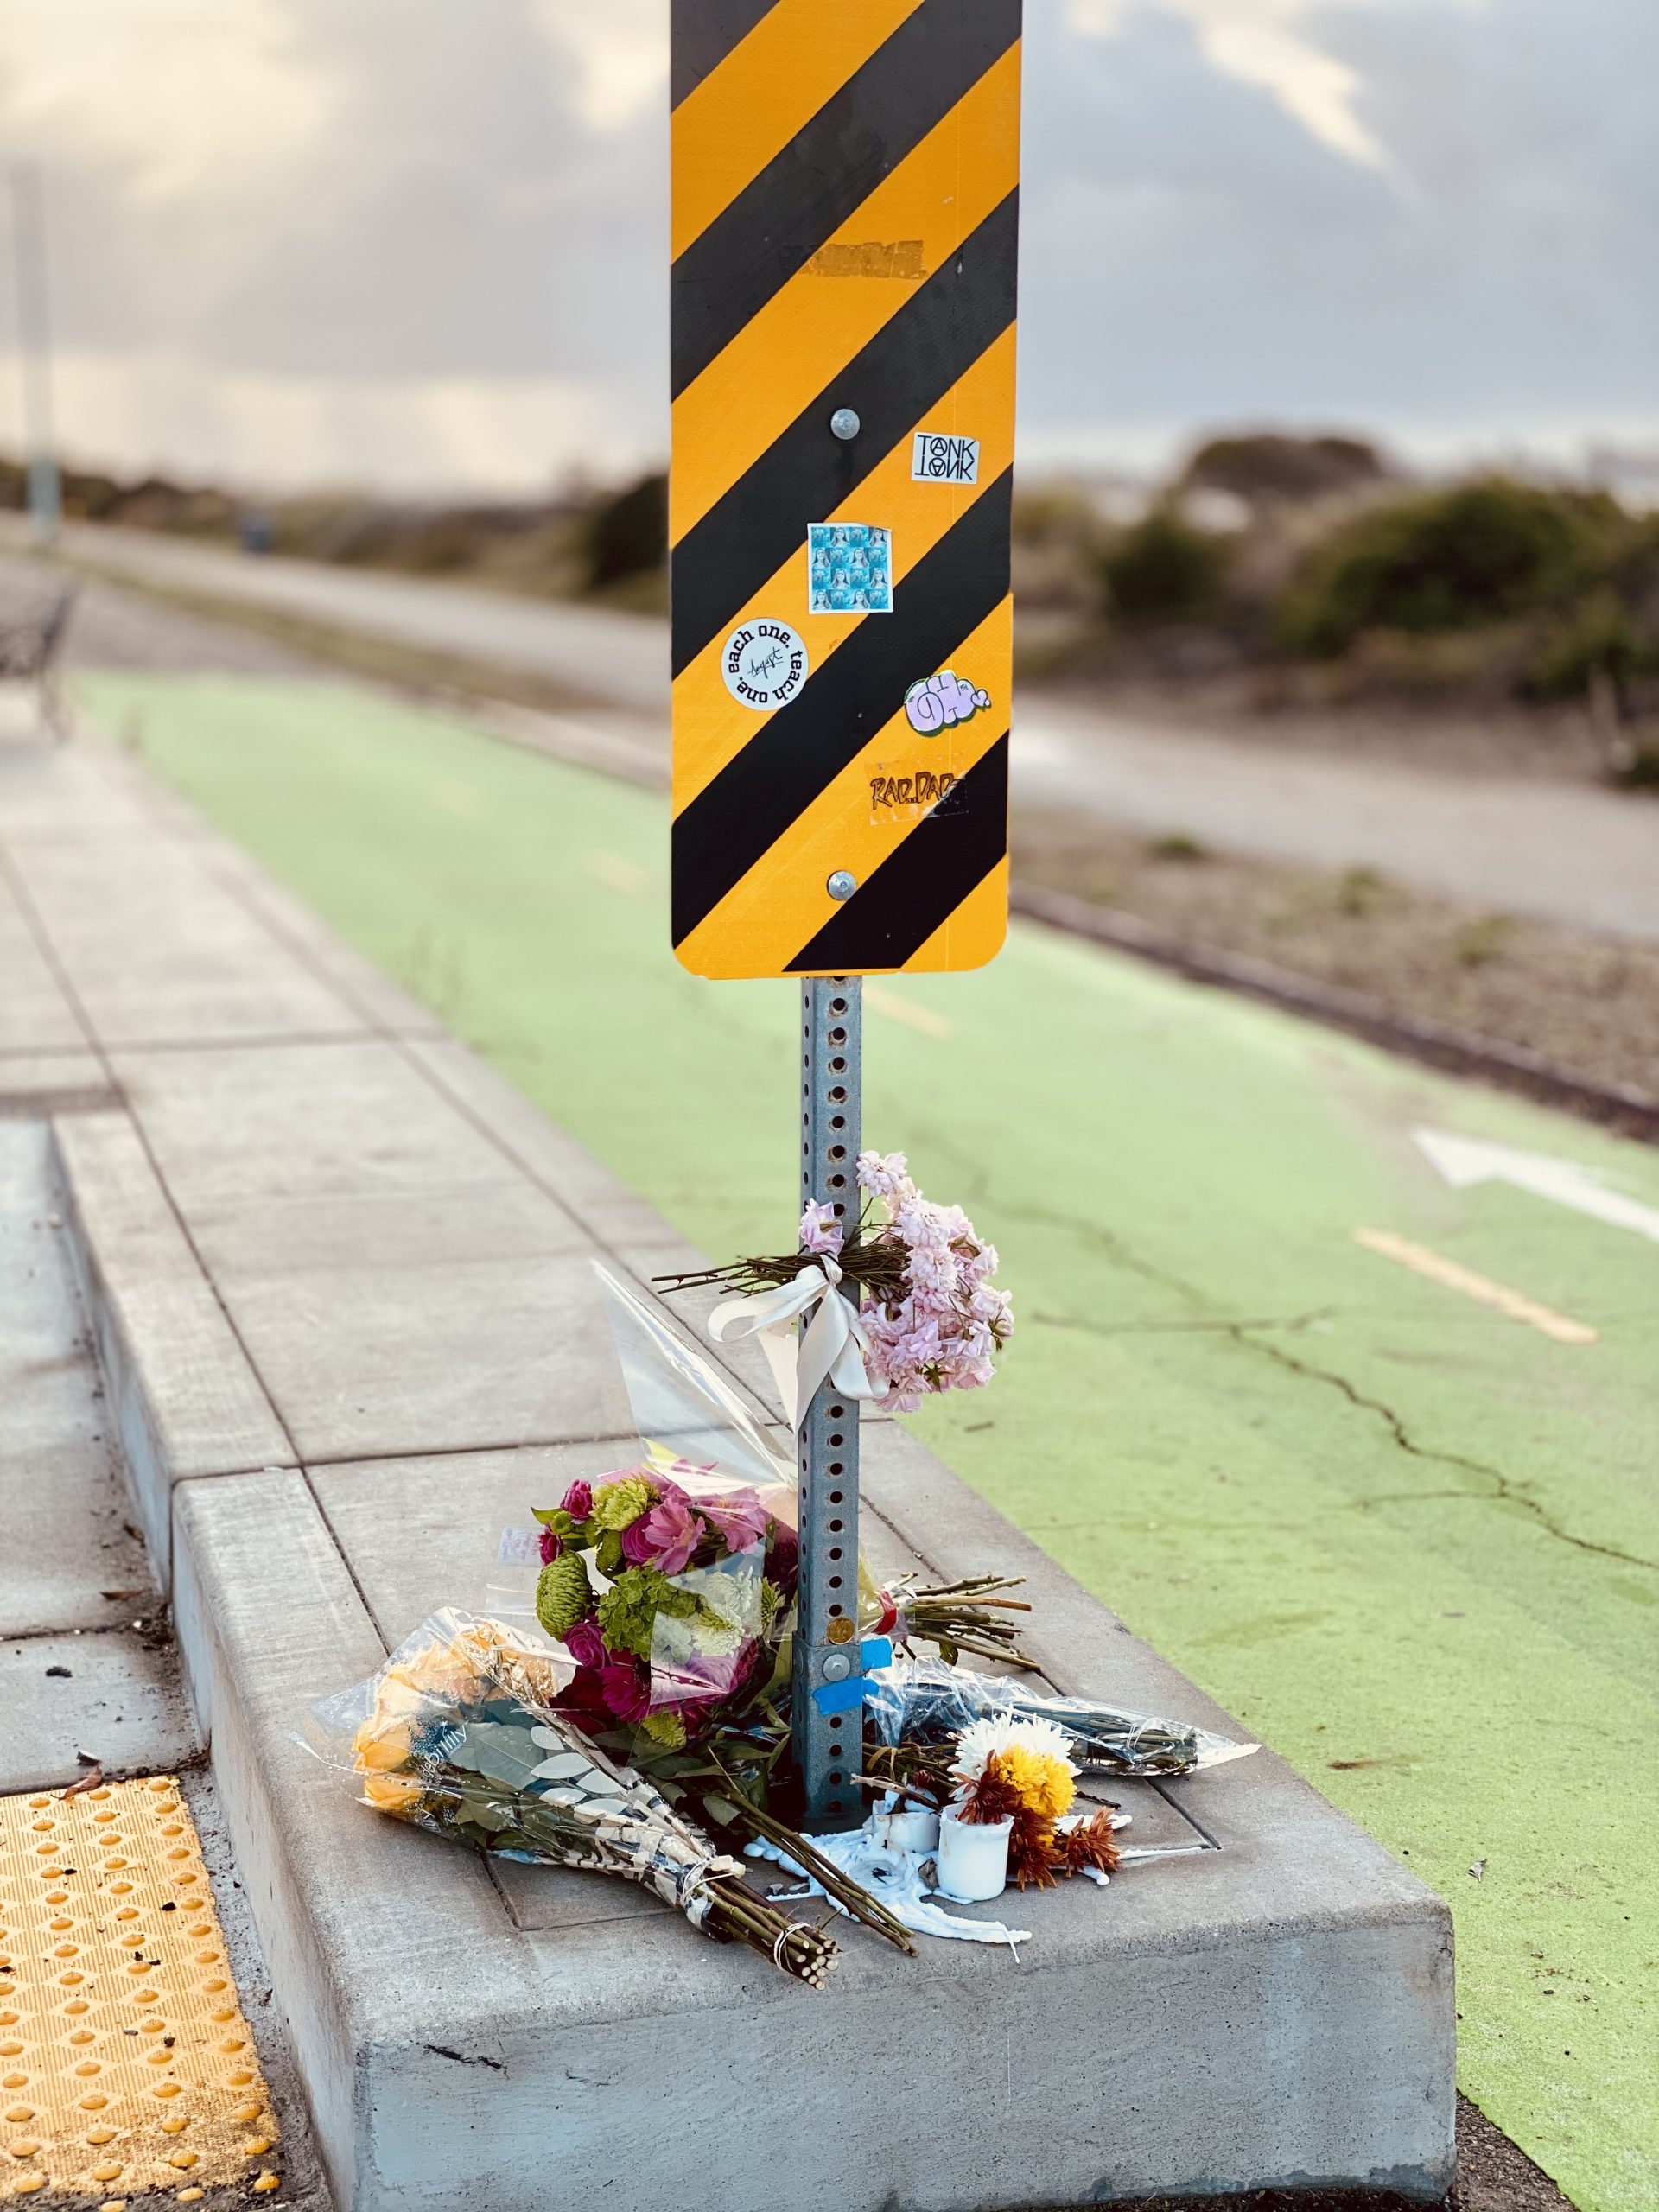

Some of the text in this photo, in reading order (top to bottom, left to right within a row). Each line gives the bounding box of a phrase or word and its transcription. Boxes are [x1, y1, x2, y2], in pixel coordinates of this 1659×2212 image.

[728, 629, 755, 673] each
[772, 650, 804, 701] teach
[870, 777, 913, 810] RAD
